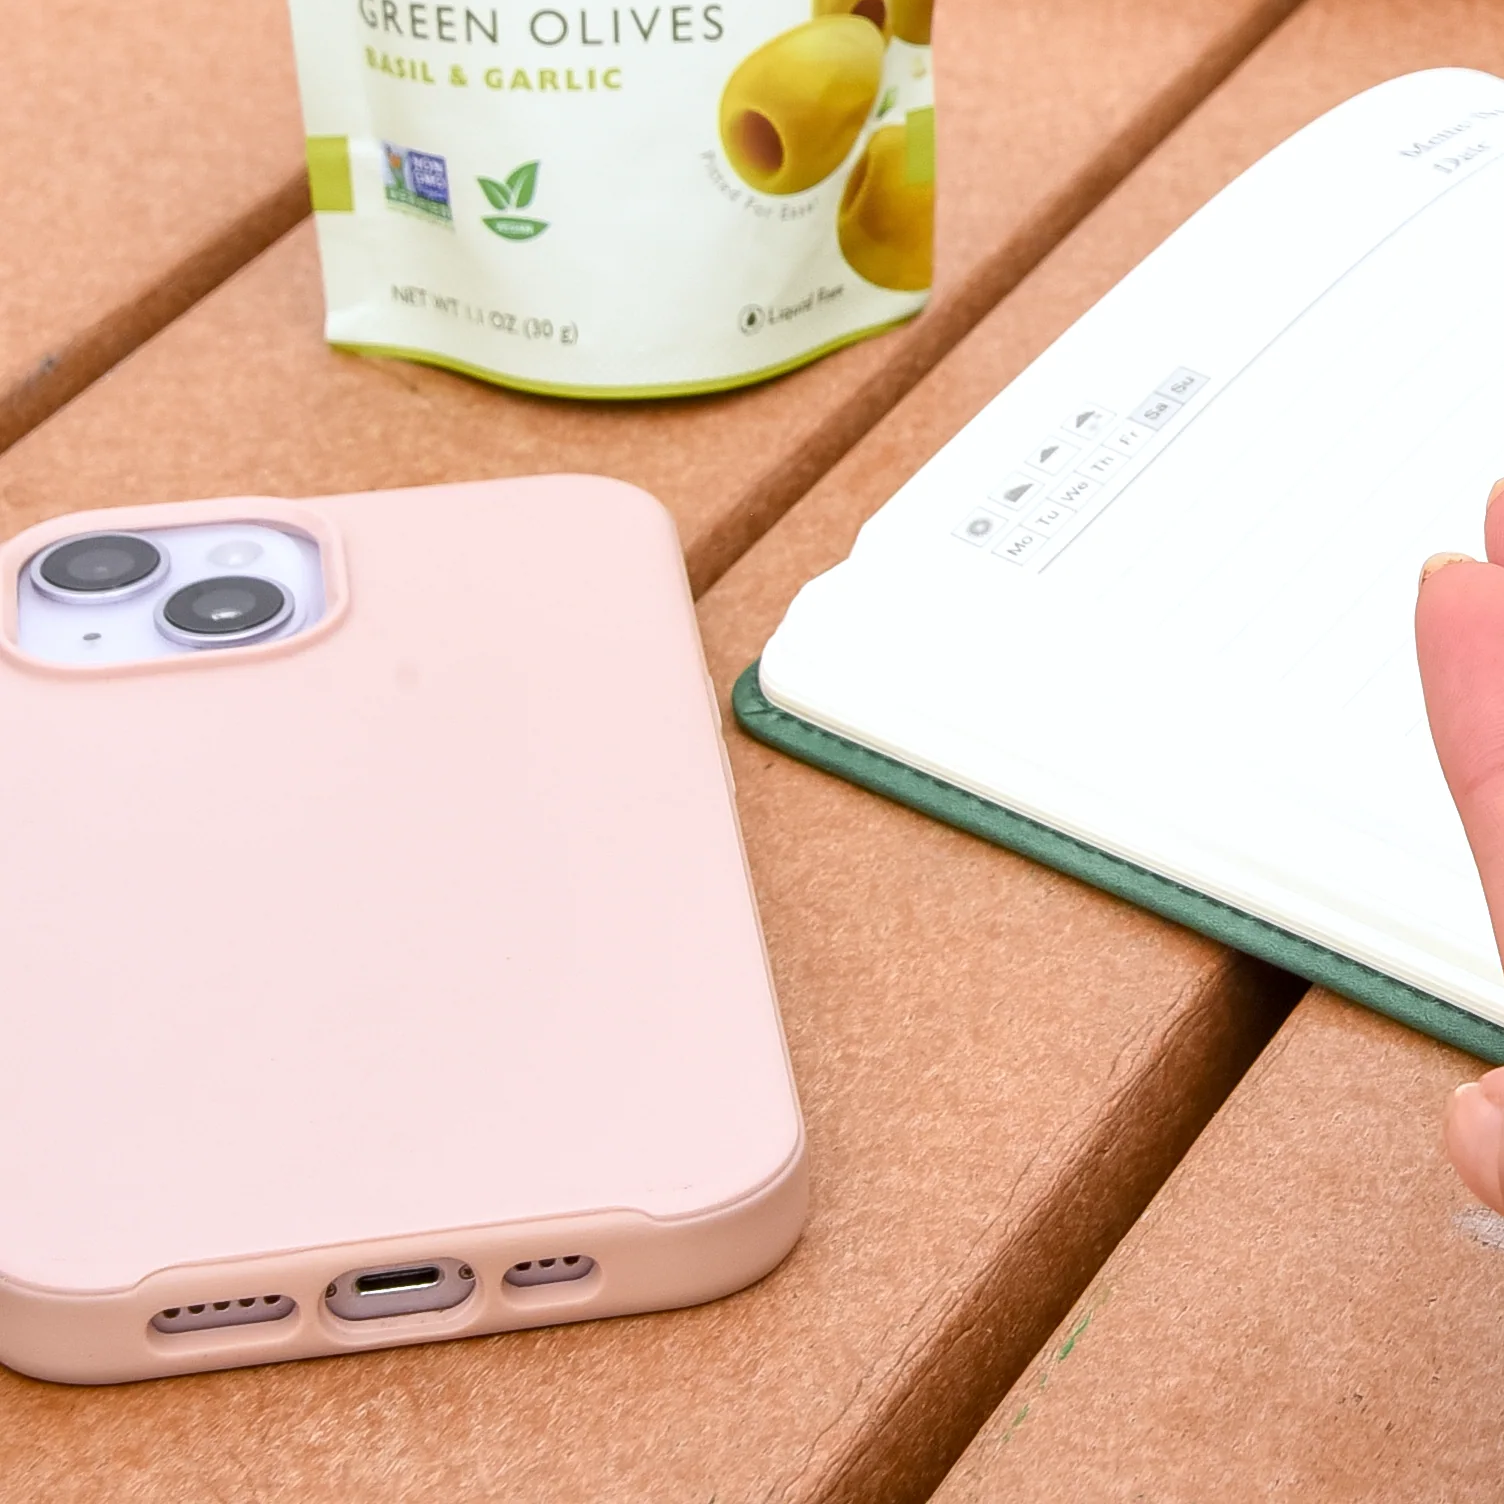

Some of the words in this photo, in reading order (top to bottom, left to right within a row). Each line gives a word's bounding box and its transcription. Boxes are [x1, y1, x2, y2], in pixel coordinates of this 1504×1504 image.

[530, 3, 724, 47] OLIVES
[364, 45, 435, 85] BASIL
[448, 63, 468, 87] &
[484, 66, 623, 92] GARLIC
[391, 284, 427, 307] NET
[489, 310, 520, 335] OZ
[1006, 534, 1034, 557] Mo
[1035, 509, 1060, 529] Tu
[1060, 481, 1089, 503] We
[1090, 455, 1115, 474] Th
[1118, 429, 1140, 447] Fr
[1143, 402, 1169, 421] Sa
[1170, 375, 1196, 394] Su
